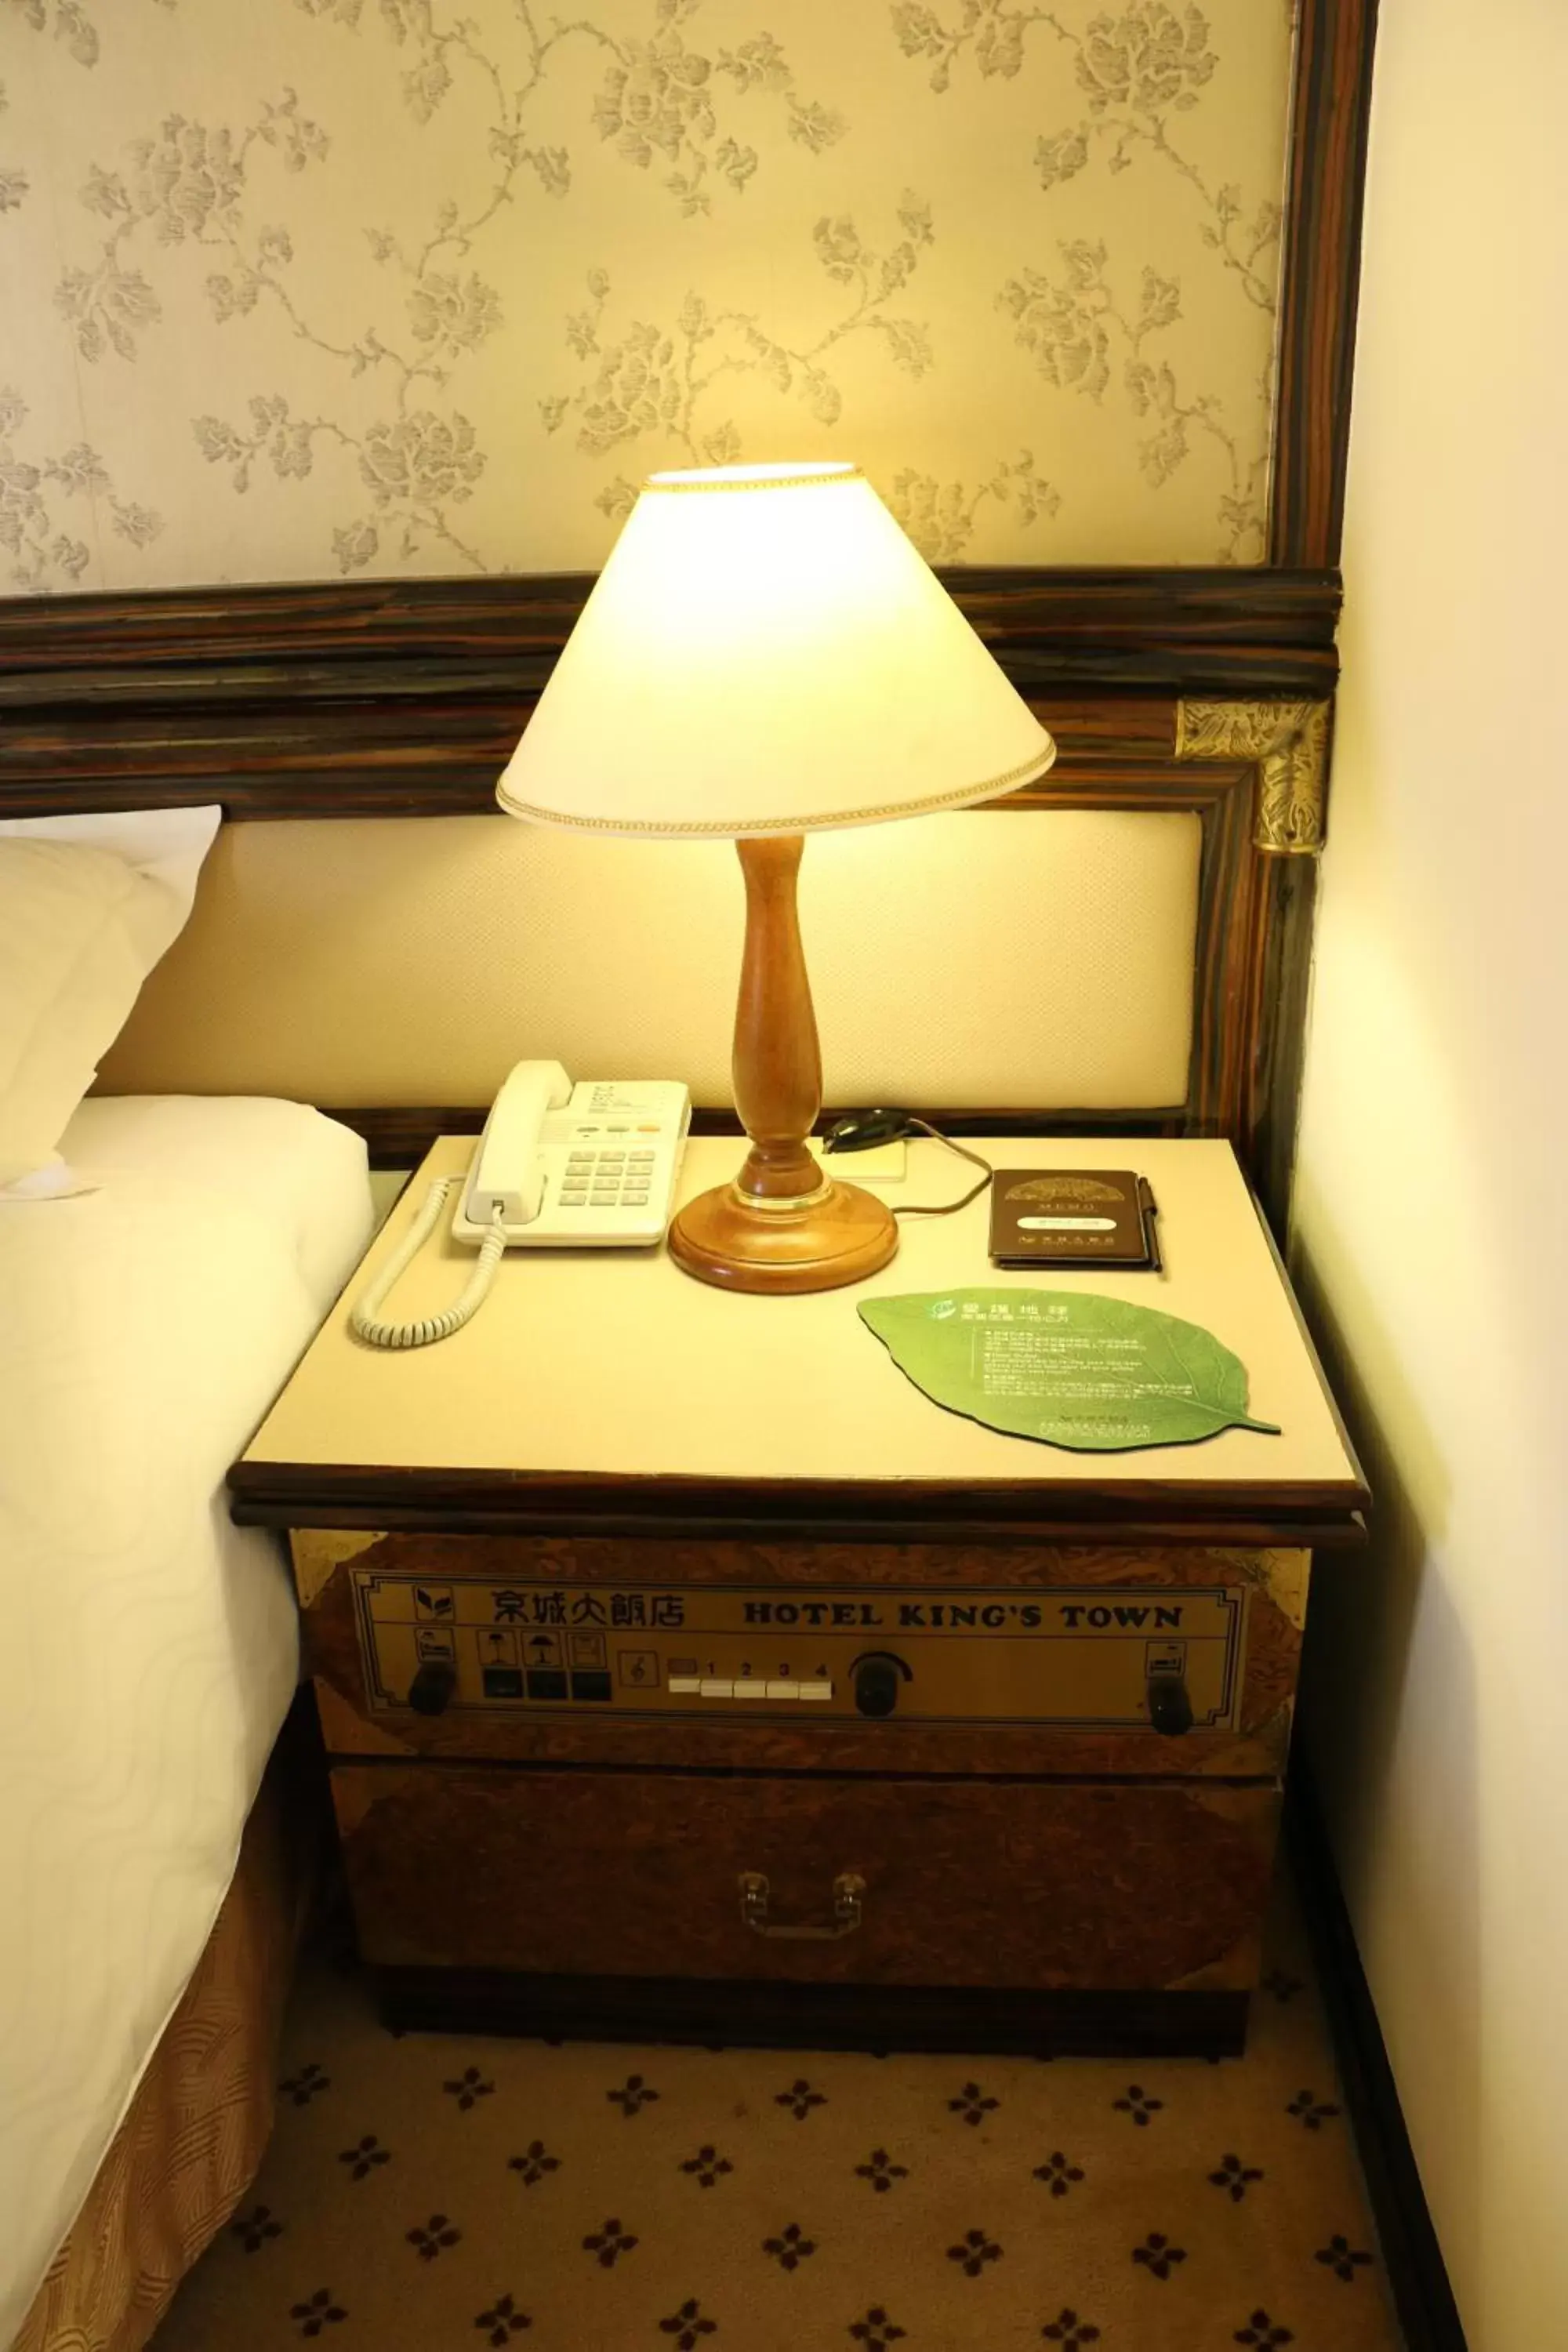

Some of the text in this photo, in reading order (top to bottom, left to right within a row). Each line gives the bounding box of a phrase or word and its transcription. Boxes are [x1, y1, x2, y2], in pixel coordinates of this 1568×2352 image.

[490, 1588, 686, 1628] 京城大飯店
[742, 1601, 1184, 1629] HOTEL KING'S TOWN
[706, 1659, 827, 1677] 1 2 3 4
